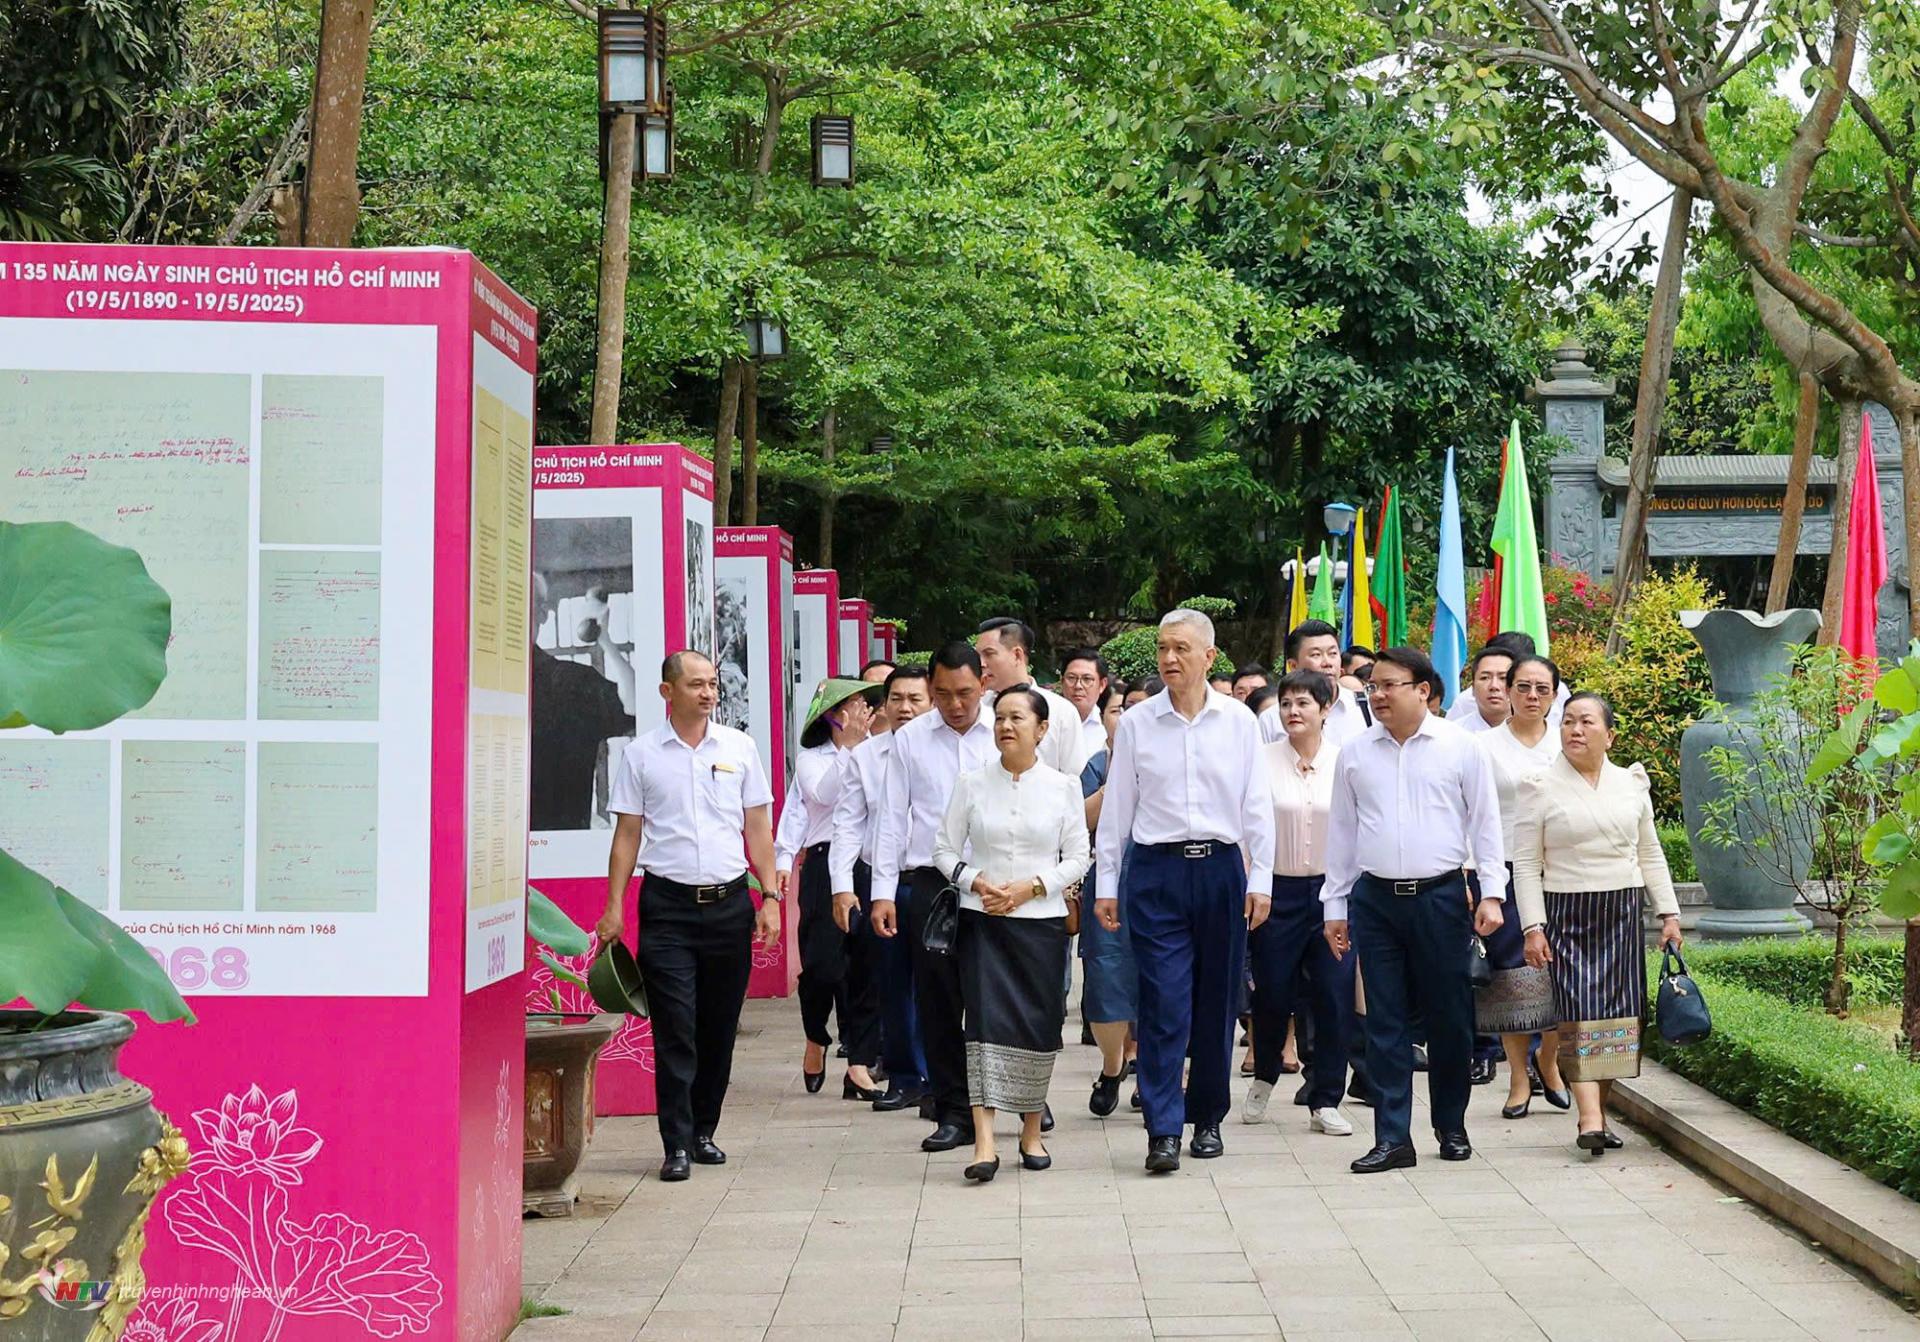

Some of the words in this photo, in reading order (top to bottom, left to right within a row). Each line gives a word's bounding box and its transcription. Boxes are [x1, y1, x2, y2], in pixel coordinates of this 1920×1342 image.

[14, 263, 47, 281] 135
[53, 260, 98, 282] NĂM
[104, 261, 160, 283] NGÀY
[165, 266, 210, 284] SINH
[216, 261, 257, 285] CHỦ
[263, 268, 308, 290] TỊCH
[314, 261, 344, 287] HỒ
[349, 266, 385, 288] CHÍ
[390, 271, 440, 288] MINH
[66, 291, 177, 312] (19/5/1890
[194, 293, 304, 317] 19/5/2025)
[534, 454, 558, 468] CHỦ
[561, 456, 586, 471] TỊCH
[590, 452, 607, 467] HỒ
[610, 454, 631, 467] CHÍ
[634, 455, 663, 467] MINH
[535, 472, 585, 485] /5/2025)
[730, 533, 745, 543] CHÍ
[746, 534, 768, 542] MINH
[123, 922, 146, 934] của
[149, 922, 174, 934] Chủ
[178, 923, 199, 936] tịch
[203, 922, 220, 934] Hồ
[222, 923, 243, 934] Chí
[246, 924, 275, 934] Minh
[278, 923, 305, 934] năm
[310, 924, 336, 935] 1968
[144, 946, 250, 990] 68
